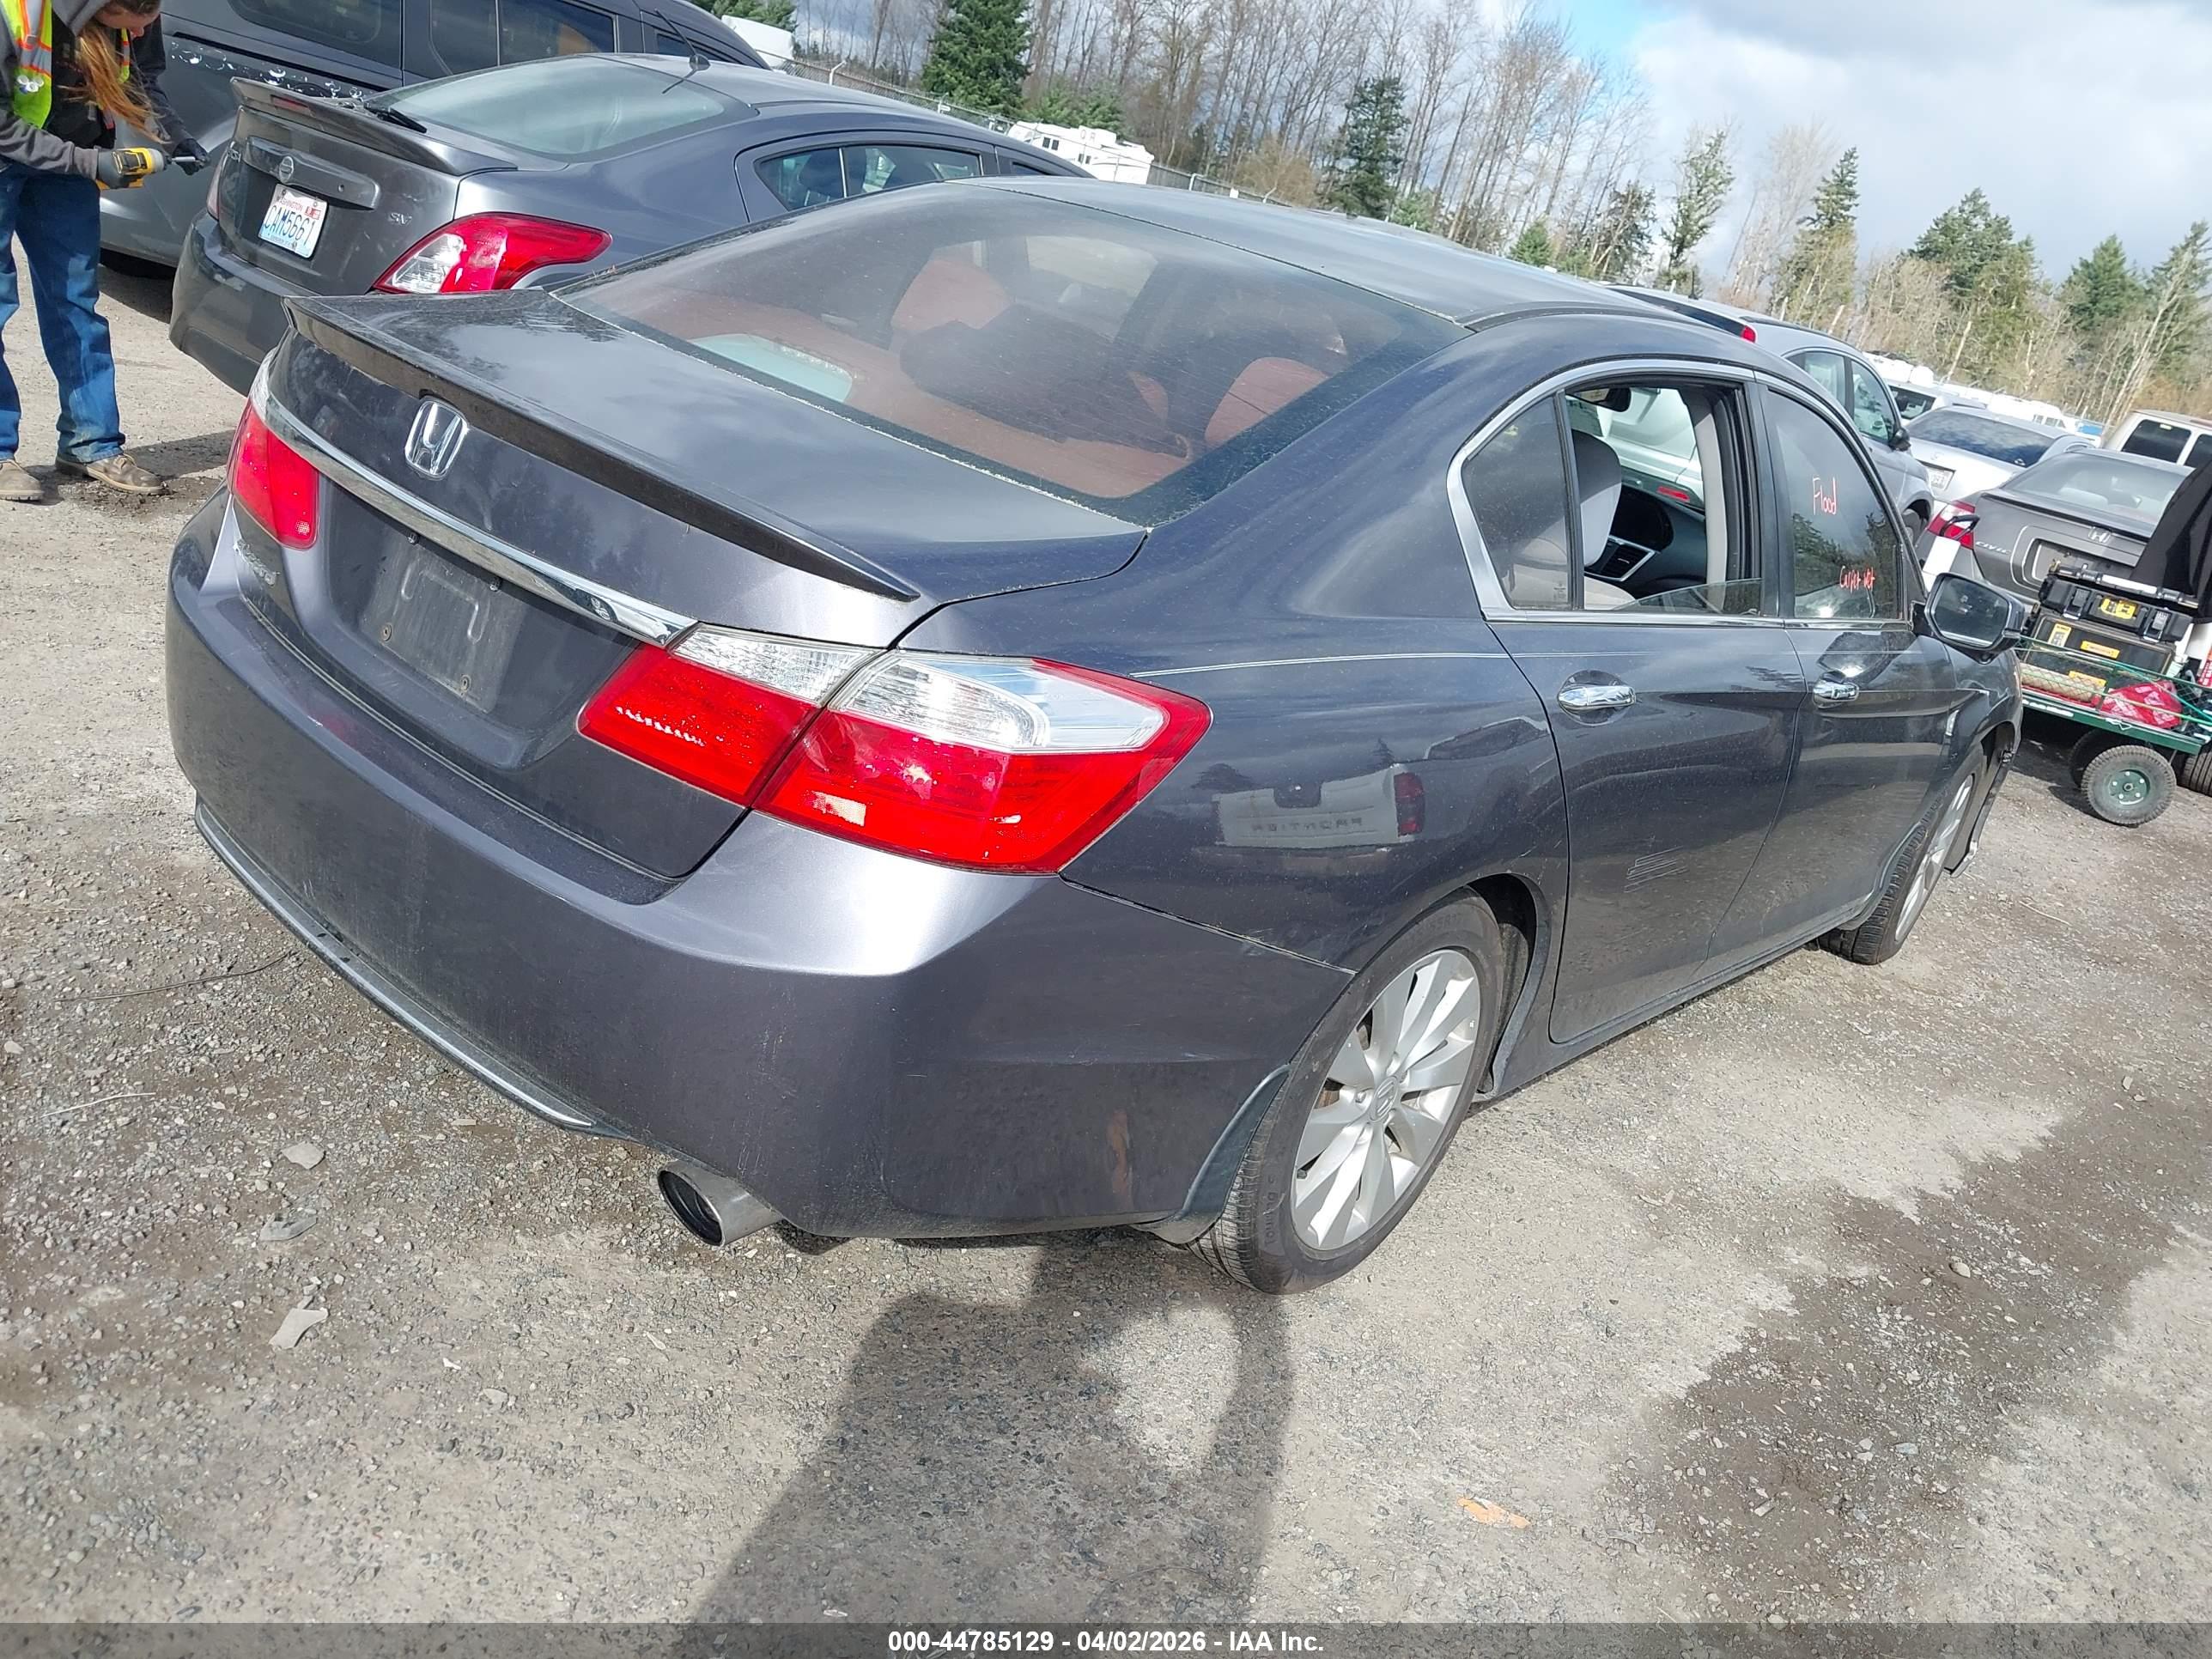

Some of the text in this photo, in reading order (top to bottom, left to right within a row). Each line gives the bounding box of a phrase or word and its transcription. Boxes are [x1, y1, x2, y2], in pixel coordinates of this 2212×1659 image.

[264, 205, 316, 246] CAM5661
[1813, 477, 1838, 515] Flood
[1975, 541, 2011, 555] CIVIC
